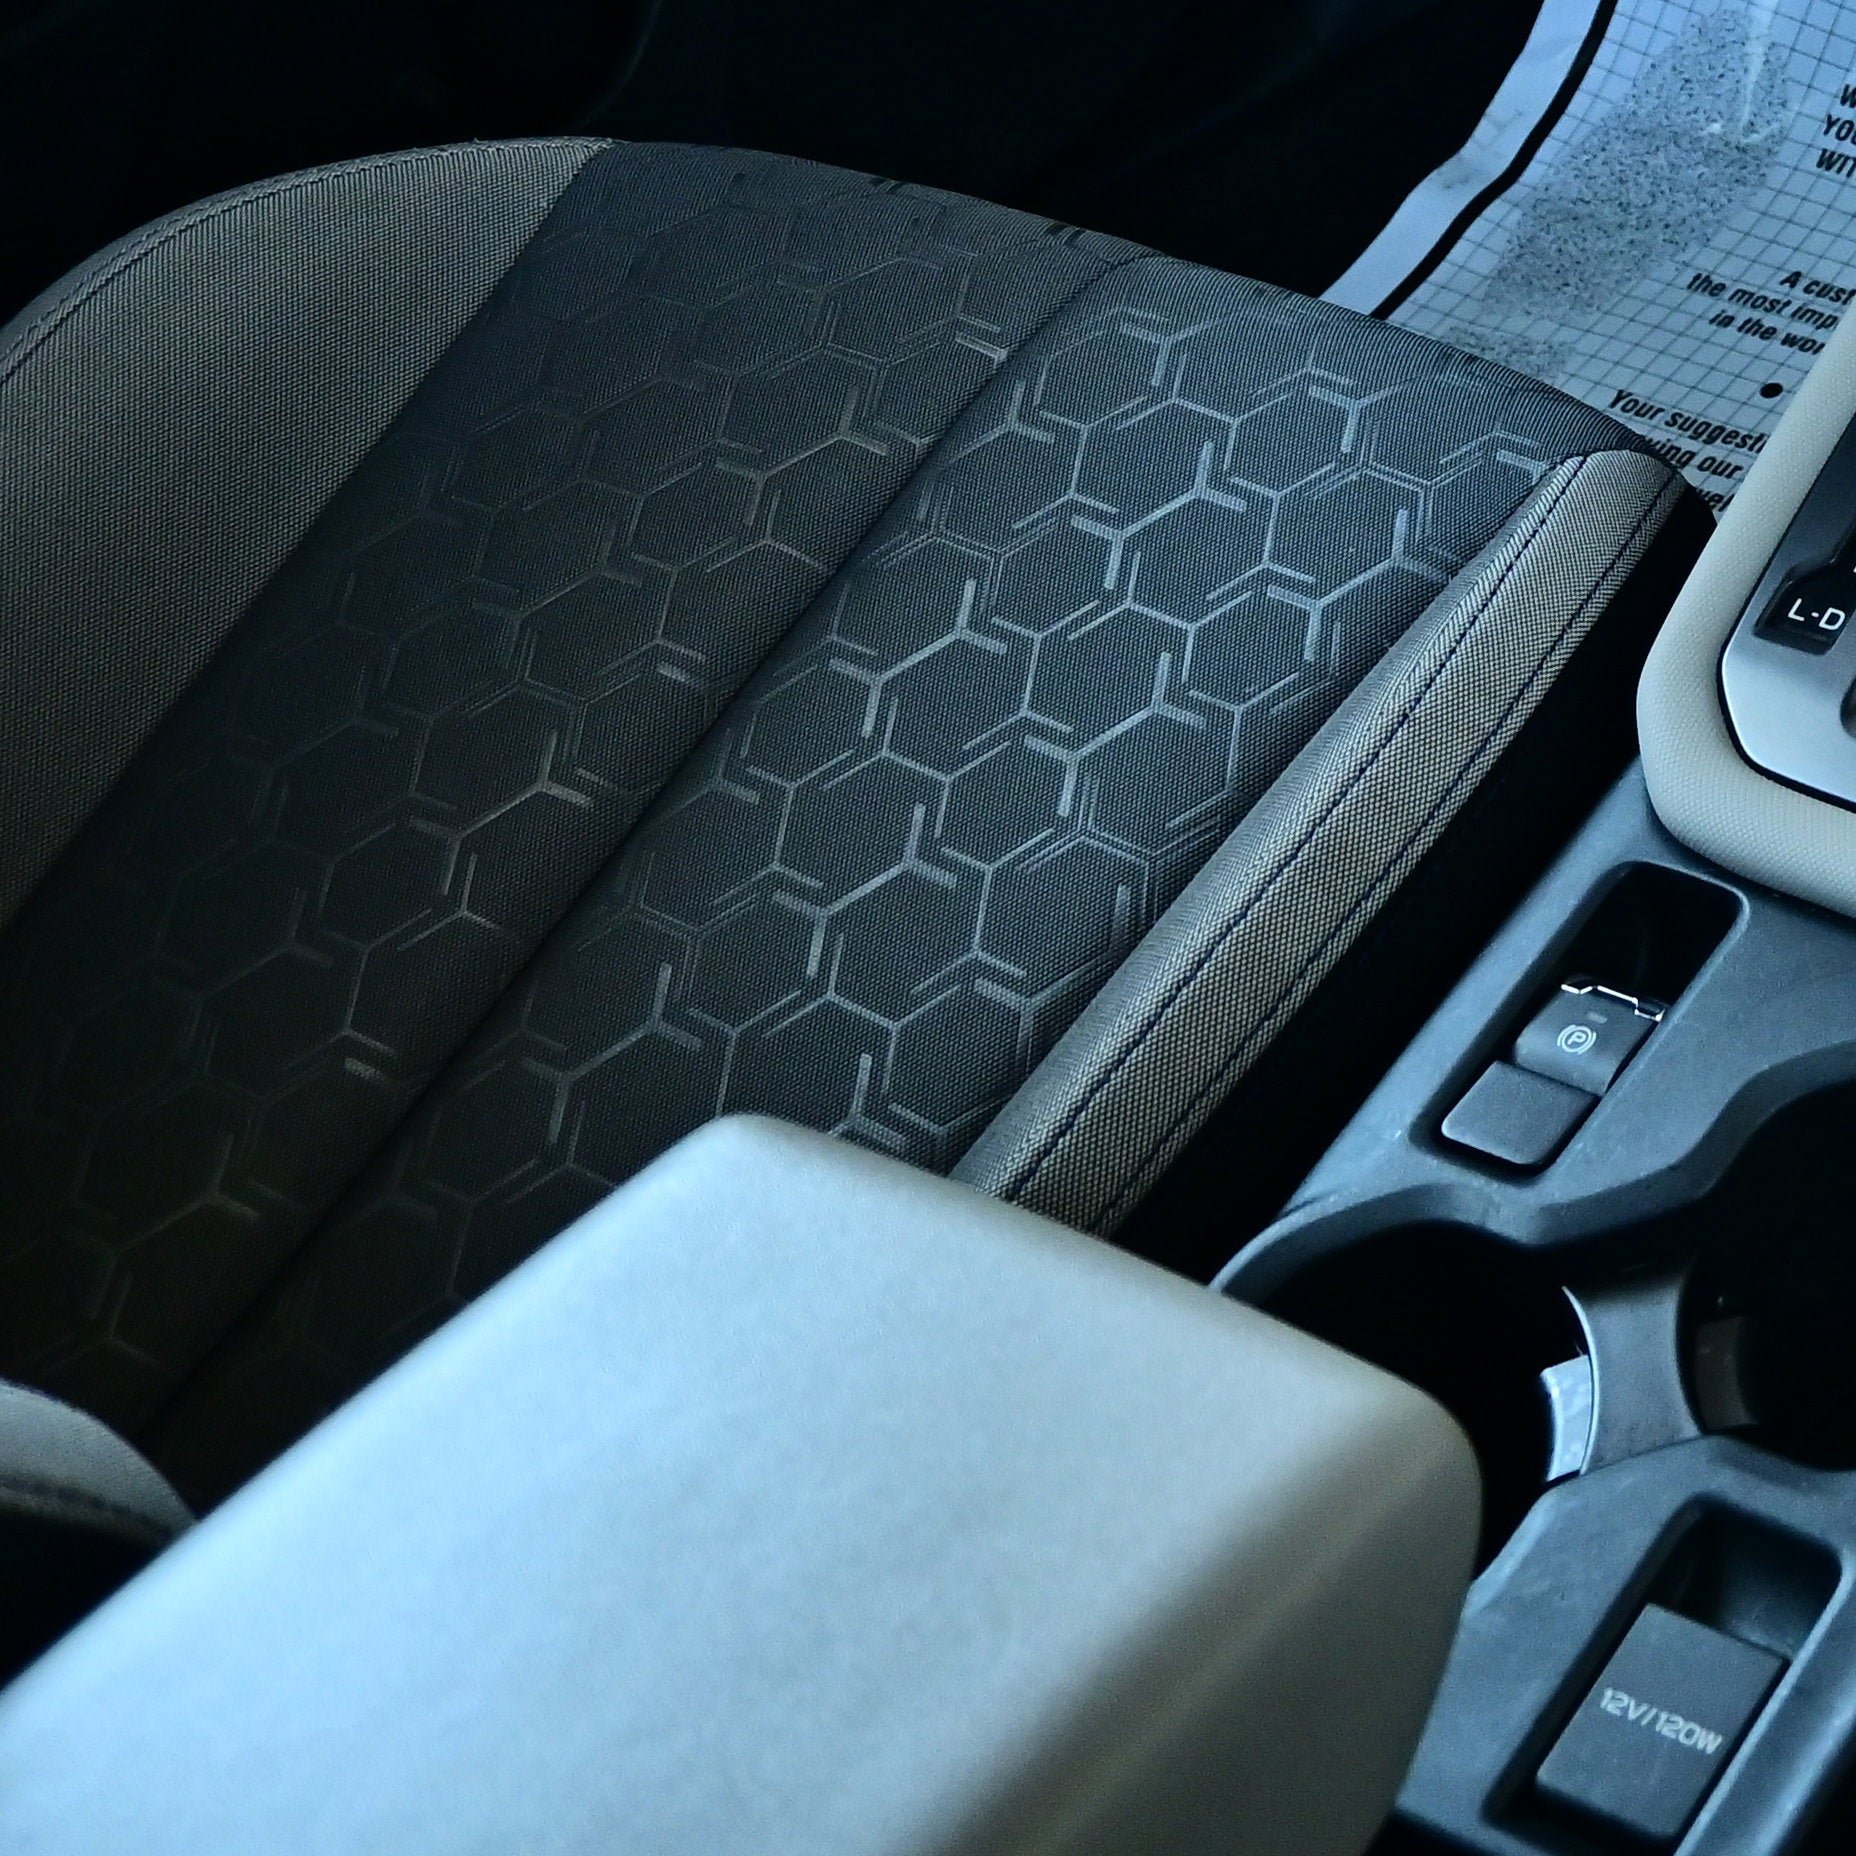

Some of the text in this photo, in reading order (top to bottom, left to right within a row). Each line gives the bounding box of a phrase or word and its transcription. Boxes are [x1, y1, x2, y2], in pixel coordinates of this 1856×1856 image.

[1686, 272, 1792, 314] the most
[1779, 270, 1803, 289] A
[1708, 309, 1777, 341] in the
[1608, 389, 1666, 420] Your
[1697, 455, 1744, 479] our
[1600, 1687, 1723, 1755] 12V/120W
